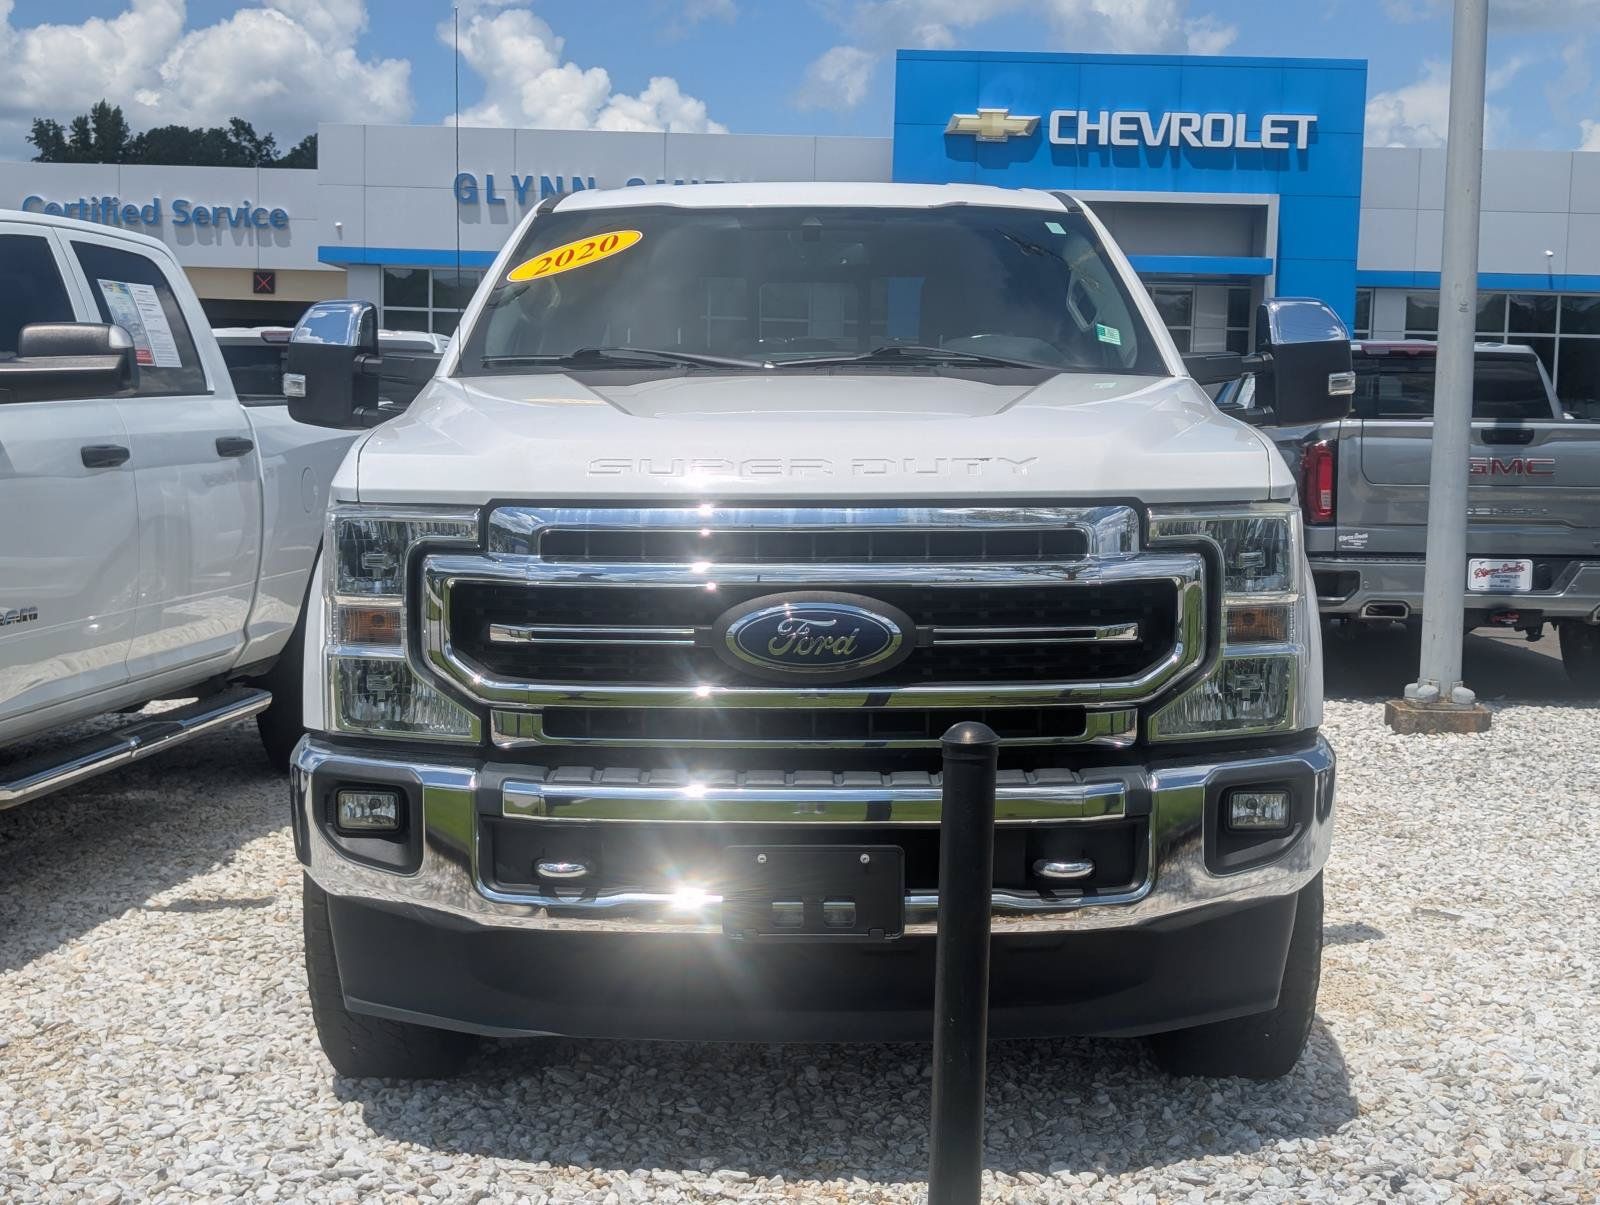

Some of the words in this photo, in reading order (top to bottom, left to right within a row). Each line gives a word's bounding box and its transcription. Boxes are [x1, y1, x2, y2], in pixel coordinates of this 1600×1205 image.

[1049, 110, 1318, 149] CHEVROLET
[453, 172, 596, 204] GLYNN
[22, 195, 161, 225] Certified
[172, 199, 289, 229] Service
[533, 234, 620, 276] 2020
[586, 457, 834, 479] SUPER
[851, 456, 1039, 478] DUTY
[1466, 456, 1555, 476] GMC
[768, 617, 860, 656] Ford
